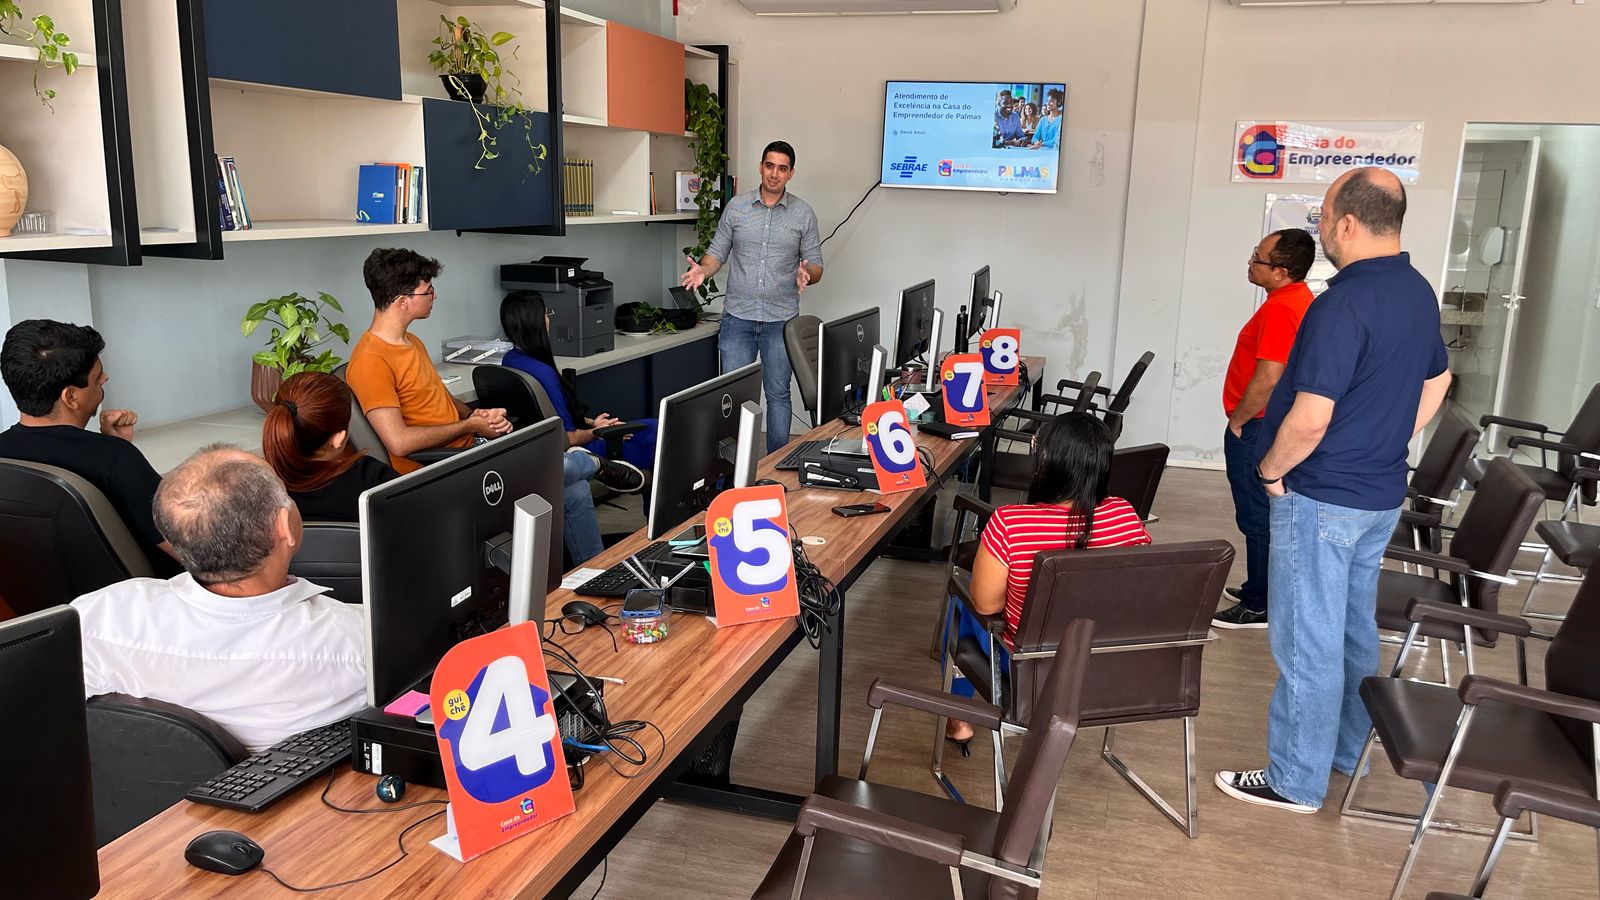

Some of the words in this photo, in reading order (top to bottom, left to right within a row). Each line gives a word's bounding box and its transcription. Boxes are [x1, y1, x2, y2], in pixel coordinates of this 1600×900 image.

[894, 92, 938, 100] Atendimento
[1334, 136, 1356, 149] do
[1288, 152, 1416, 167] Empreendedor
[890, 162, 928, 172] SEBRAE
[998, 165, 1049, 179] PALMAS
[990, 335, 1018, 370] 8
[953, 362, 985, 408] 7
[878, 411, 916, 464] 6
[485, 481, 502, 495] DELL
[733, 498, 791, 585] 5
[448, 693, 463, 707] gui
[450, 702, 466, 715] chê
[459, 655, 556, 776] 4
